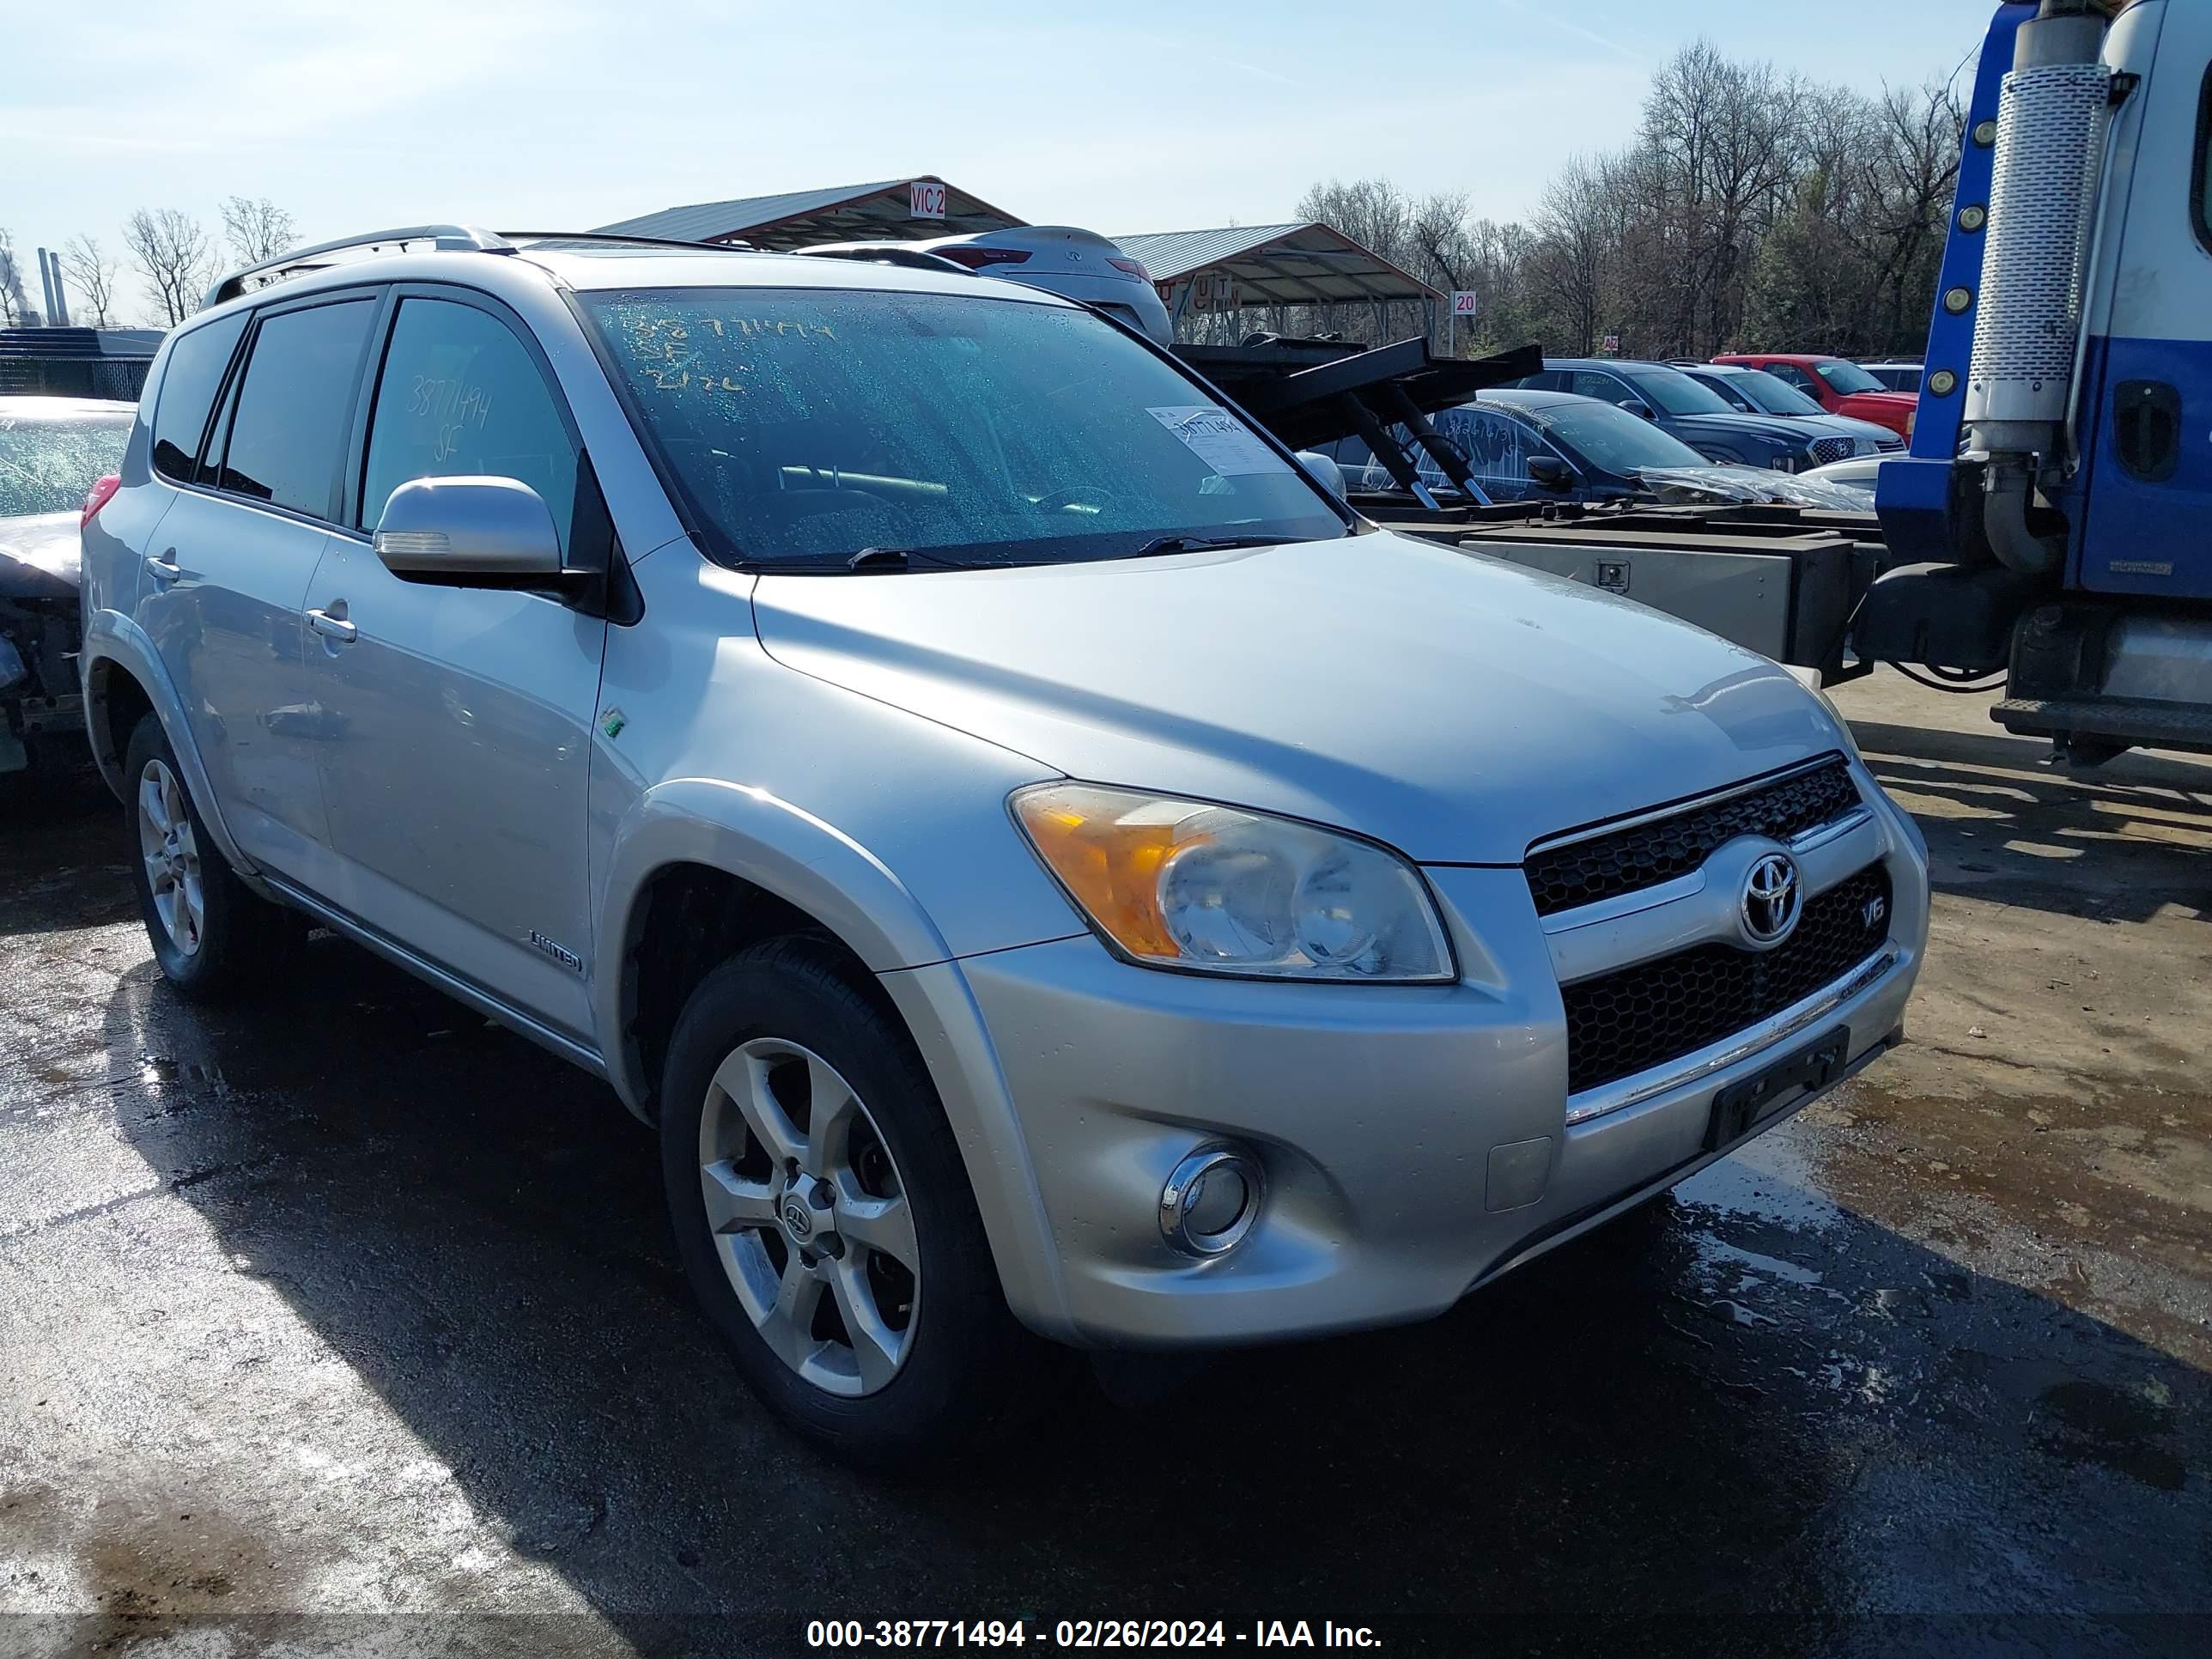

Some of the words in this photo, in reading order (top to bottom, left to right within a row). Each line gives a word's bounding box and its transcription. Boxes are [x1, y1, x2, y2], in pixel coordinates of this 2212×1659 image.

[912, 186, 933, 213] VIC
[937, 189, 945, 214] 2
[1456, 295, 1474, 310] 20
[407, 374, 492, 429] 38771494
[434, 423, 465, 463] SF
[1174, 420, 1243, 435] 38771494
[1863, 896, 1884, 927] V6
[529, 928, 583, 972] LIMITED
